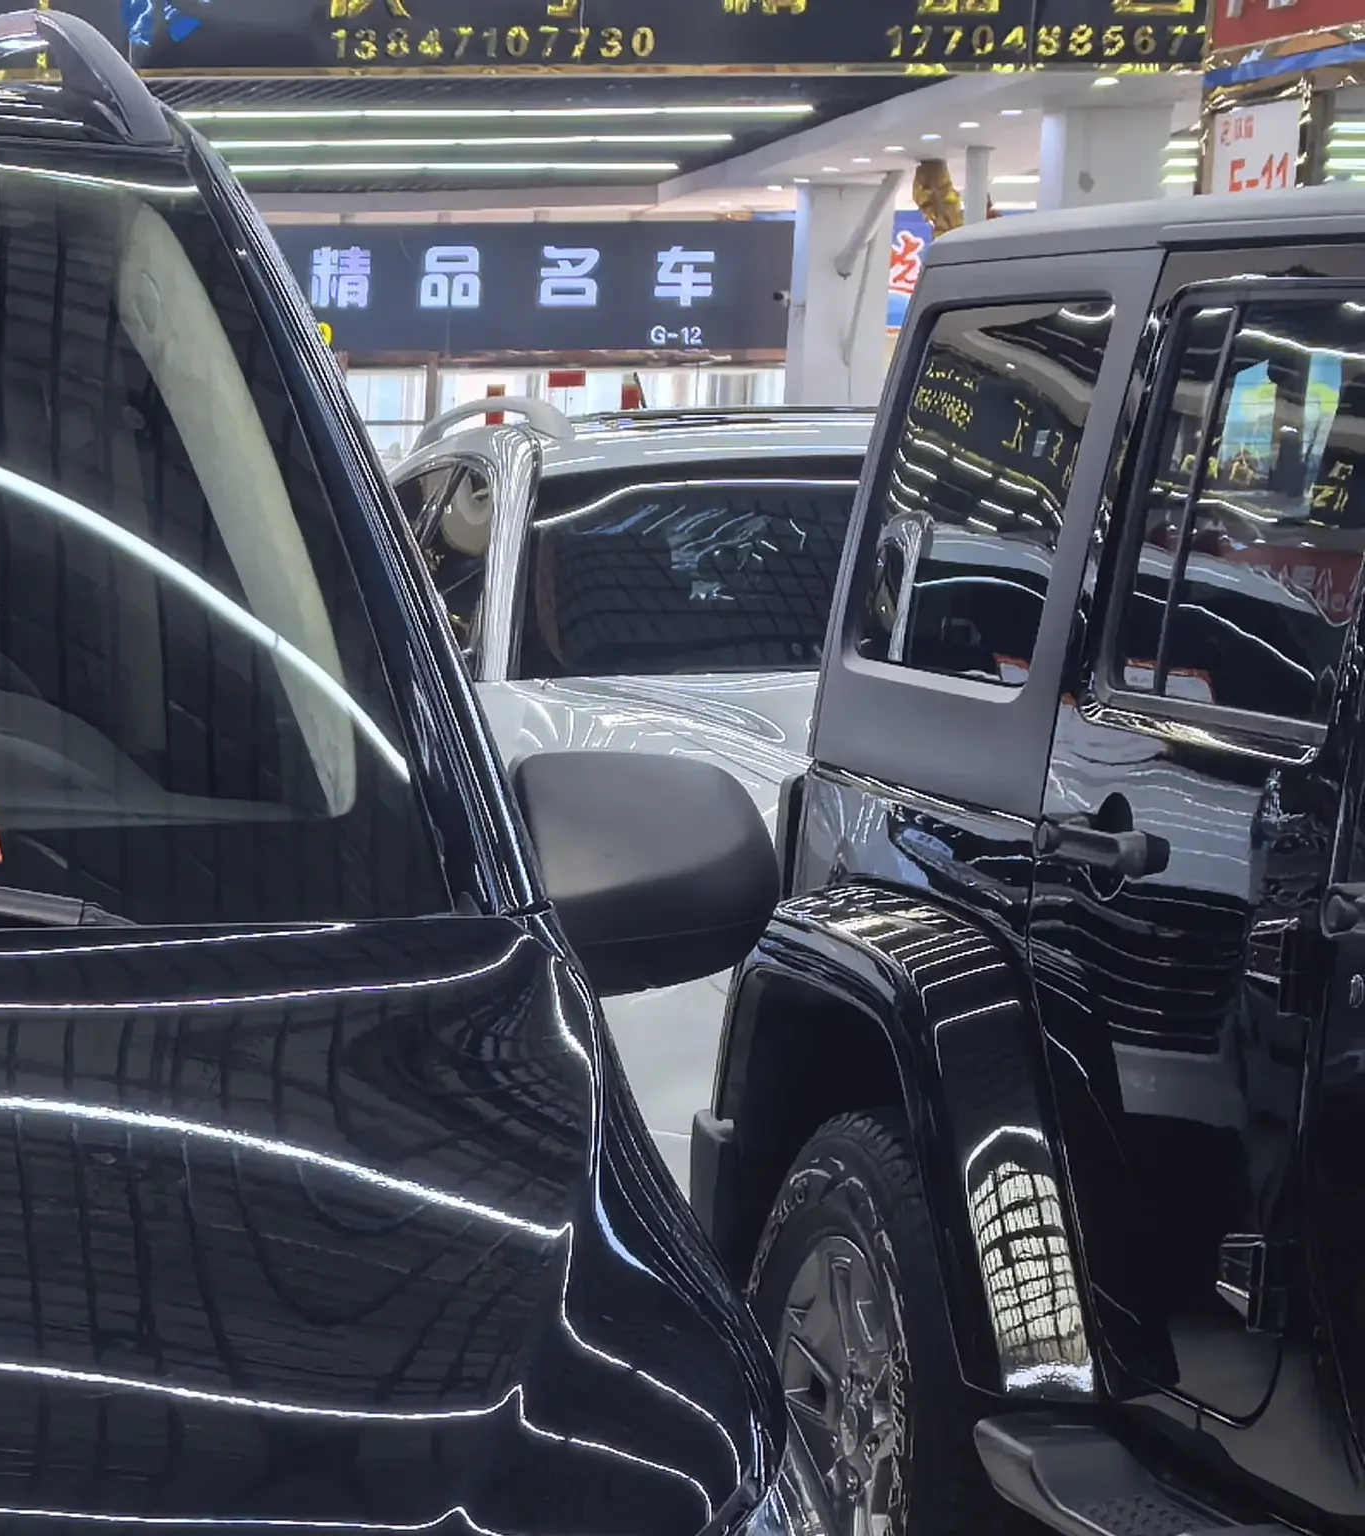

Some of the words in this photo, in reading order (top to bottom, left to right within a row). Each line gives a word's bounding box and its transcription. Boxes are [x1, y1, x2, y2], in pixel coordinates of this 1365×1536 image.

[311, 245, 715, 308] 精品名车
[650, 325, 703, 346] G-12
